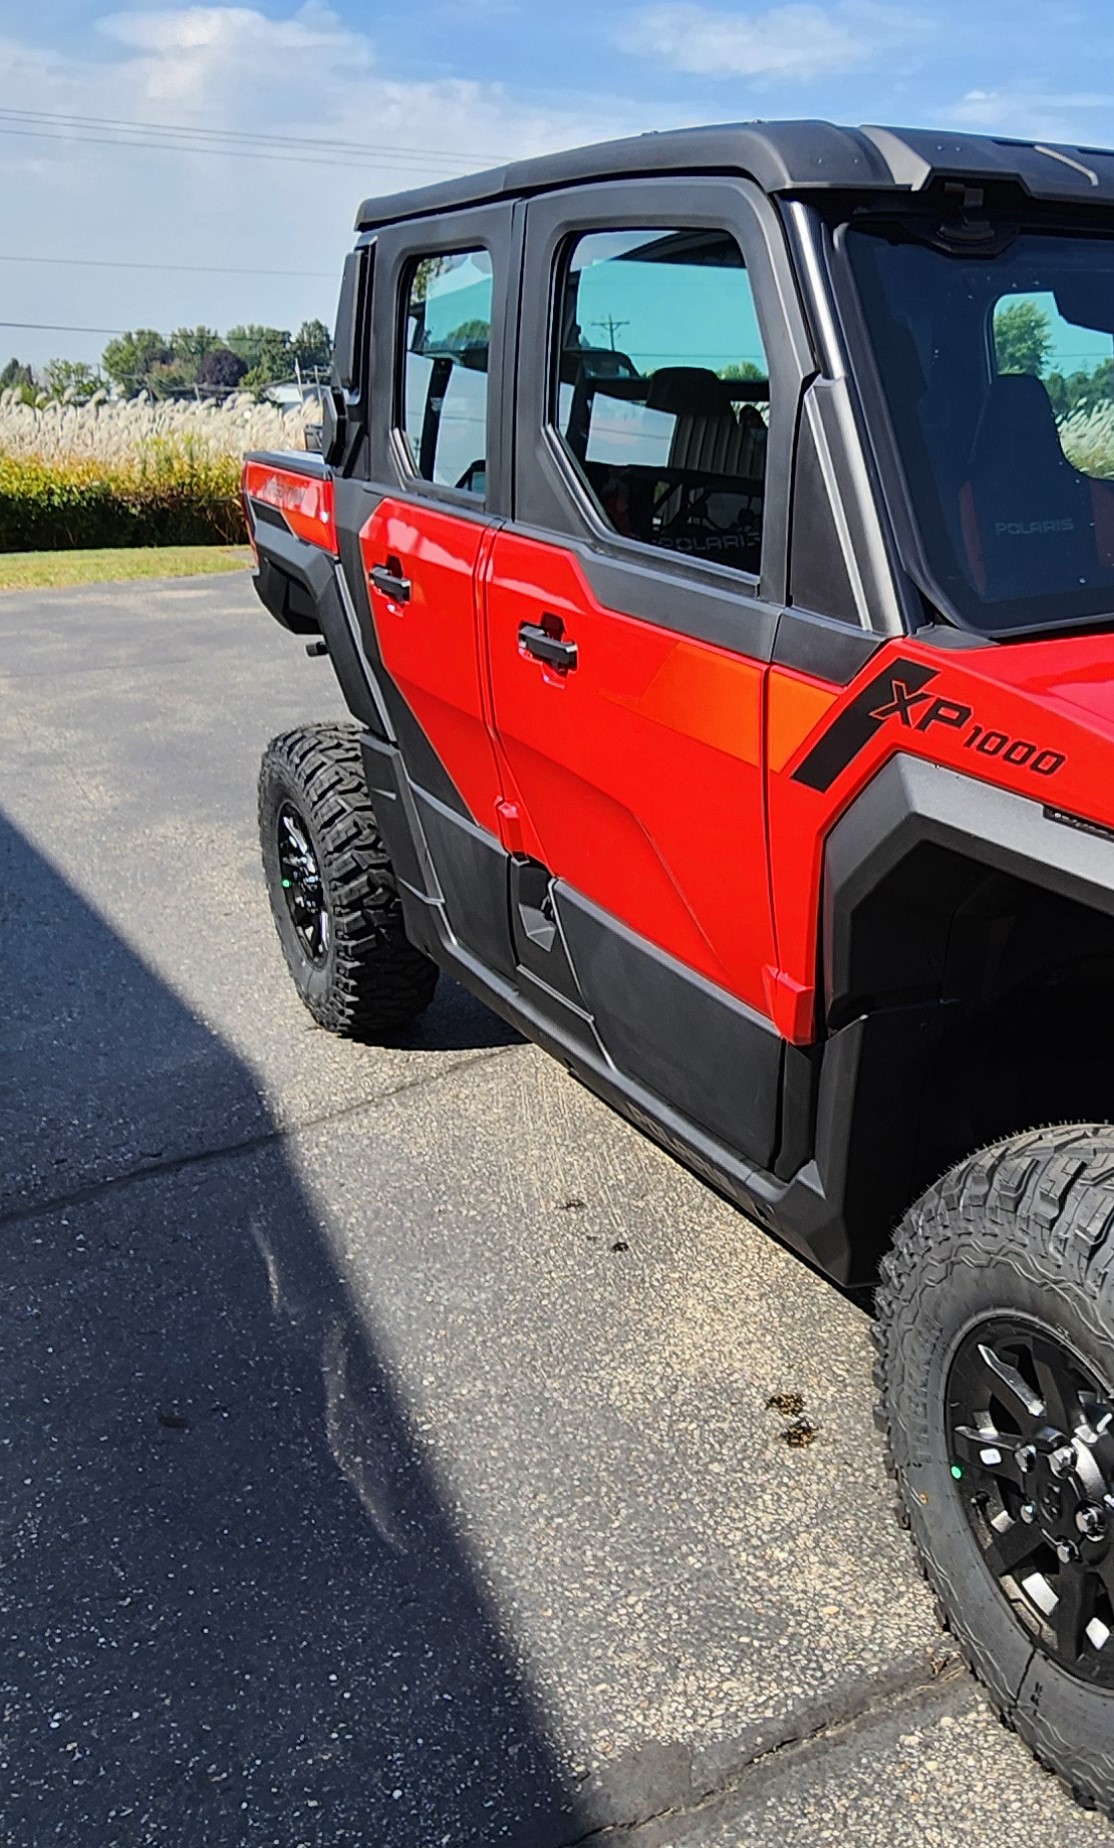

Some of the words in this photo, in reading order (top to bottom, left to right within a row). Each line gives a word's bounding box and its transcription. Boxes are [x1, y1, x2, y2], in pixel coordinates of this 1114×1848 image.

[995, 518, 1074, 536] POLARIS
[869, 680, 973, 732] XP
[963, 724, 1067, 777] 1000
